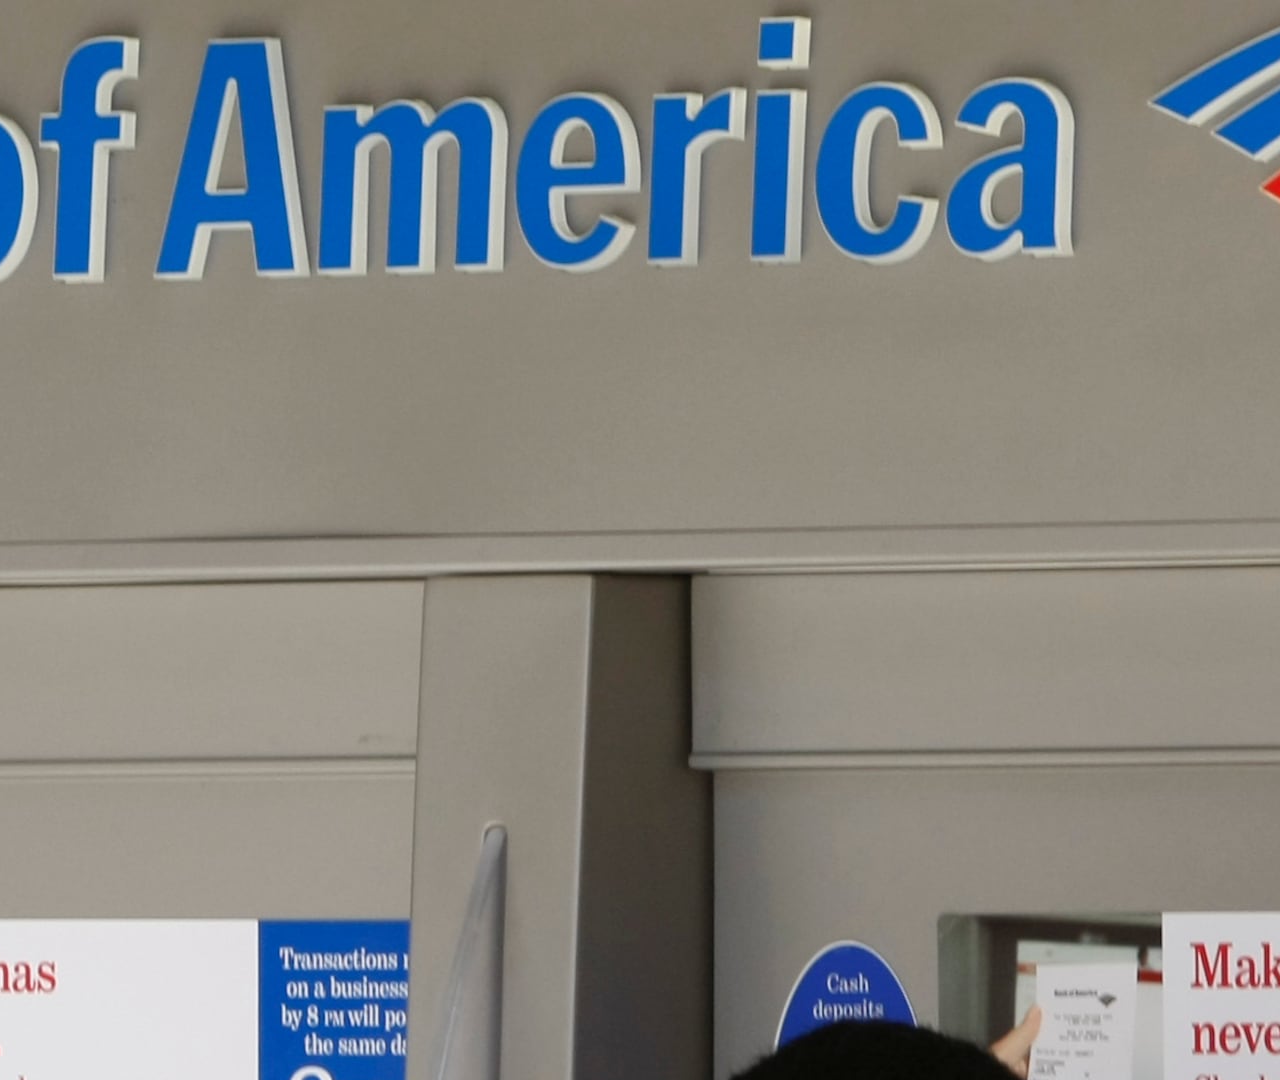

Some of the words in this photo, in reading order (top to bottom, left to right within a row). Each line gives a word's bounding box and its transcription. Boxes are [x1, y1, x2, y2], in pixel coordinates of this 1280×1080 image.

[153, 15, 1075, 280] America
[279, 946, 398, 971] Transactions
[286, 981, 308, 999] on
[314, 981, 326, 999] a
[330, 975, 408, 999] business
[827, 972, 869, 994] Cash
[281, 1003, 302, 1031] by
[307, 1004, 319, 1028] 8
[324, 1010, 344, 1027] PM
[348, 1004, 379, 1027] will
[385, 1010, 406, 1032] po
[813, 999, 884, 1021] deposits
[304, 1033, 333, 1056] the
[339, 1038, 386, 1056] same
